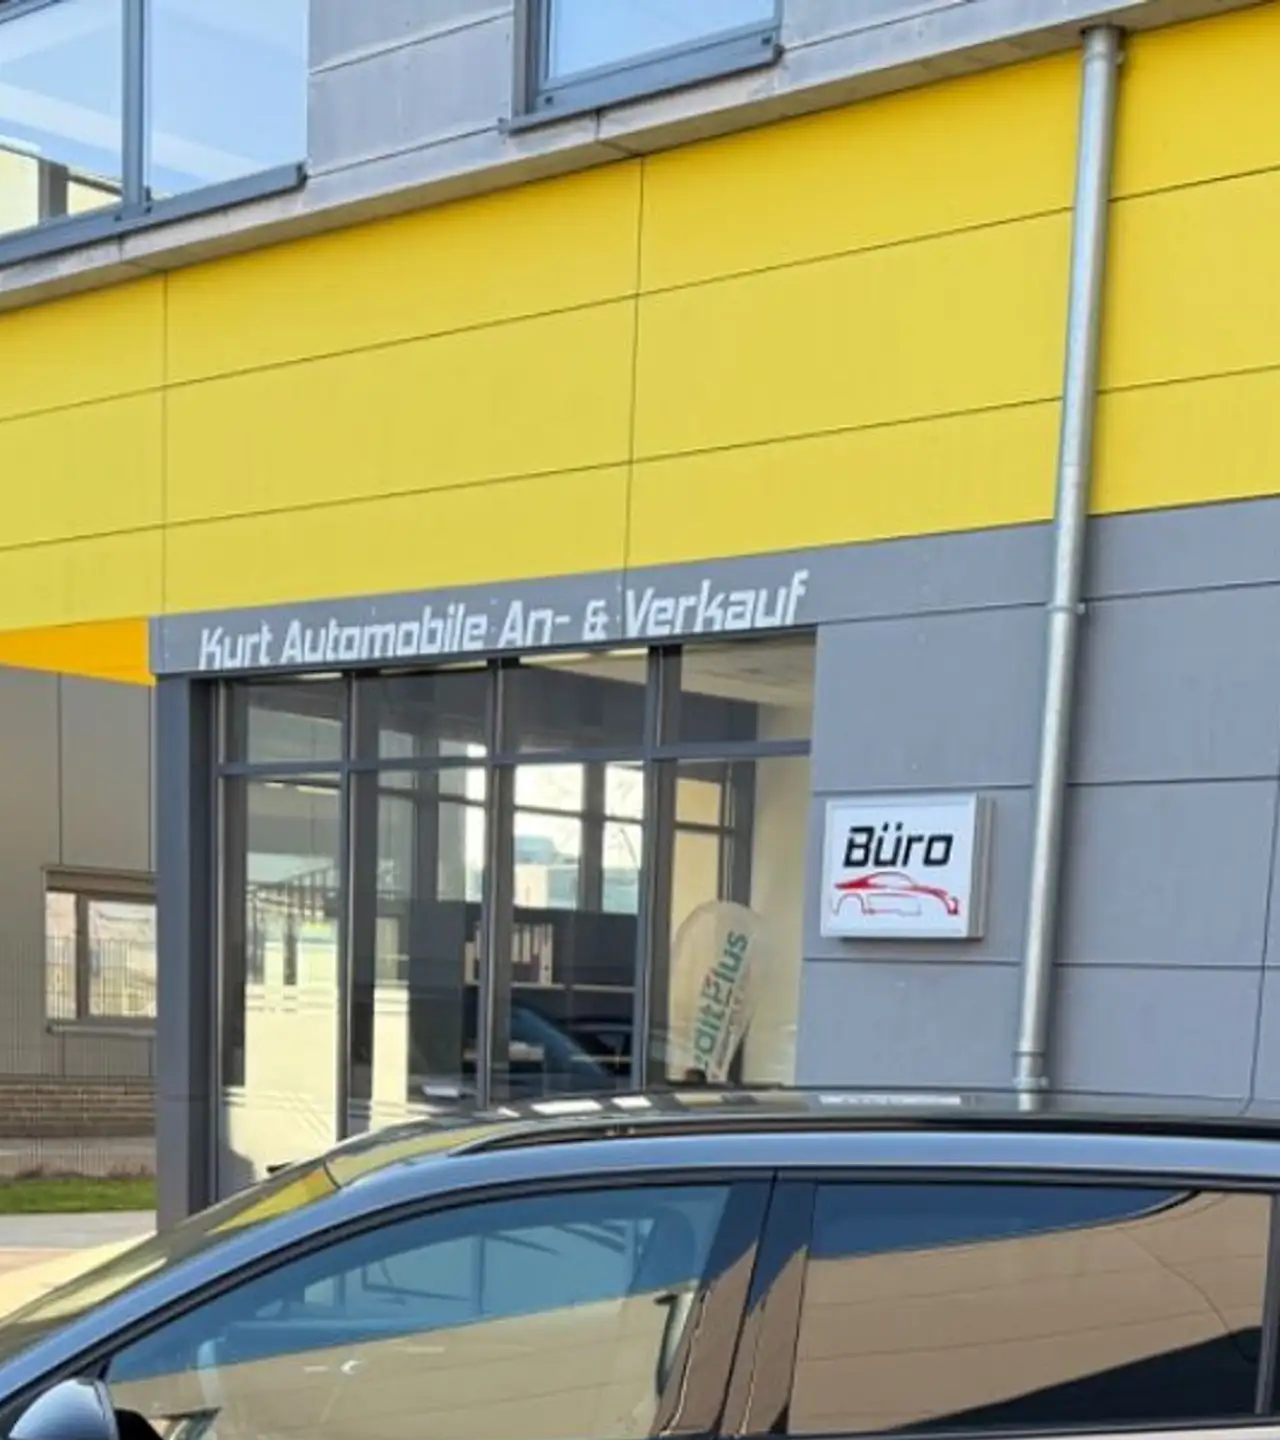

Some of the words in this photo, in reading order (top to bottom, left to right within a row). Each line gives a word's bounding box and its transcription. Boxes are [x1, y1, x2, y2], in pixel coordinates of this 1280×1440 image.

[198, 620, 272, 671] Kurt
[279, 602, 488, 665] Automobile
[496, 599, 571, 649] An-
[582, 599, 609, 642] &
[624, 568, 810, 638] Verkauf
[843, 821, 955, 868] Büro
